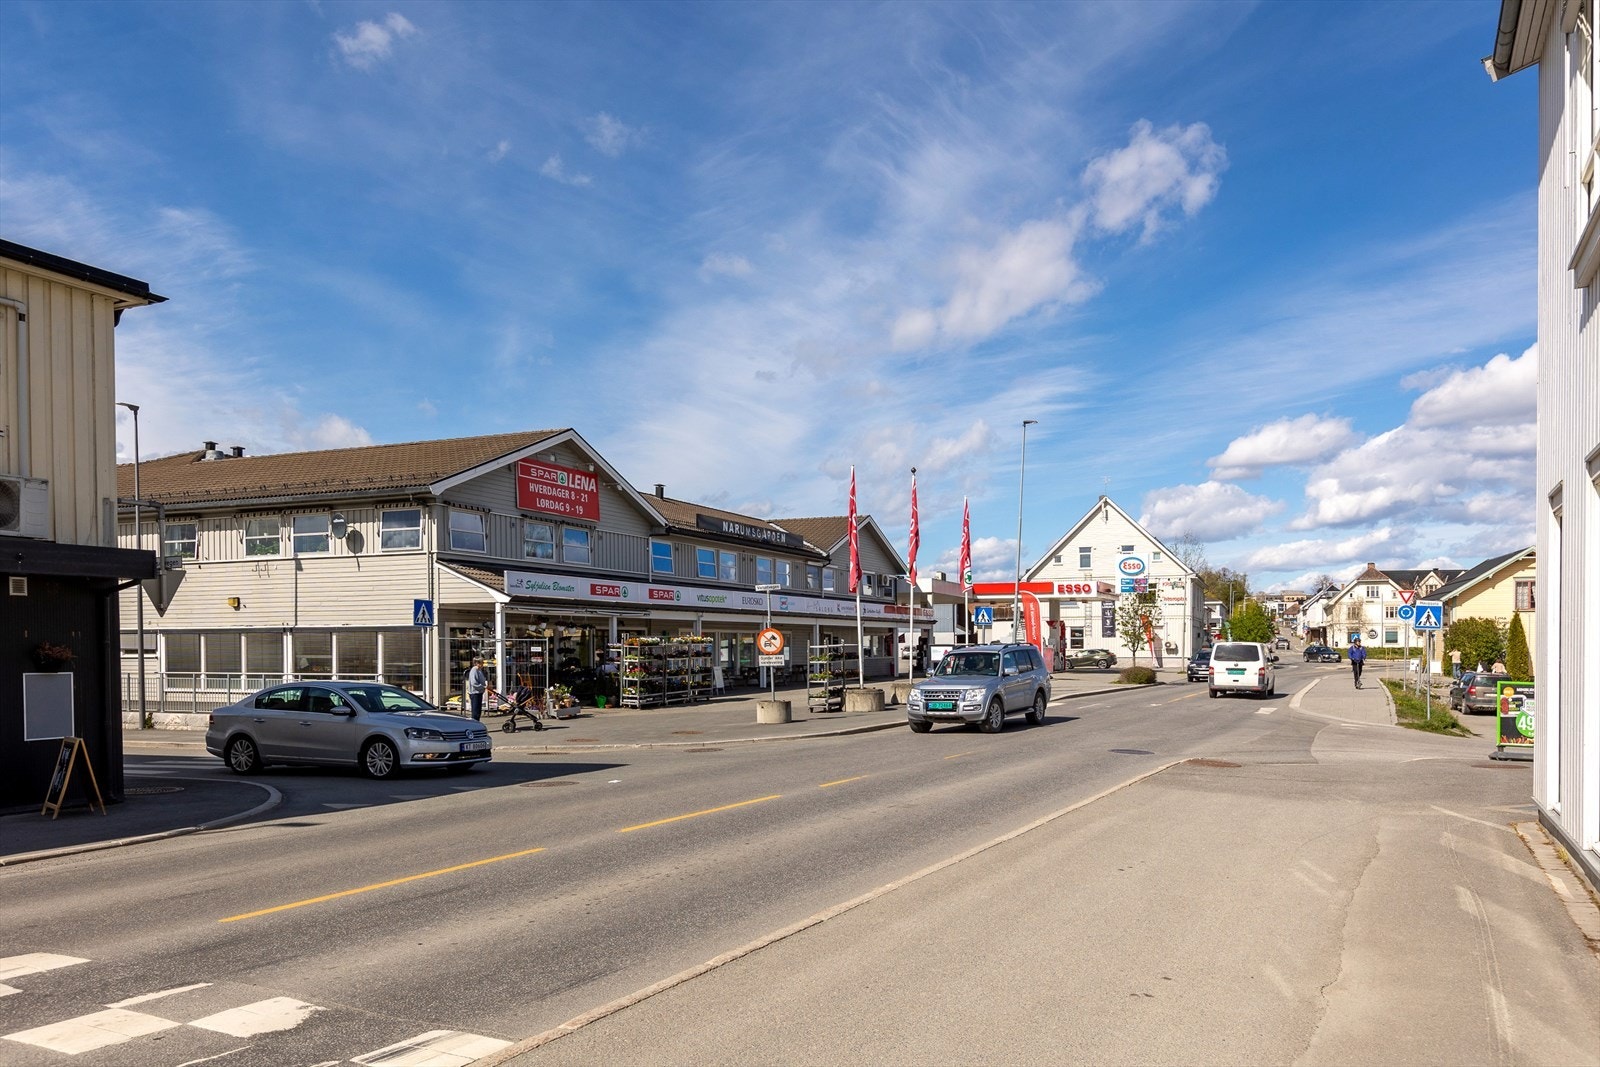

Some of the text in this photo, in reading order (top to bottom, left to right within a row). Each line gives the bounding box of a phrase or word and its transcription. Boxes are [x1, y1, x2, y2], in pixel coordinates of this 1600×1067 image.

[530, 468, 597, 493] SPAR LENA
[529, 482, 570, 499] HVERDAGER
[571, 491, 576, 500] 8
[581, 493, 588, 502] 21
[536, 498, 565, 511] LØRDAG
[566, 504, 570, 512] 9
[575, 505, 584, 515] 19
[595, 586, 620, 595] SPAR
[653, 590, 674, 599] SPAR
[1057, 584, 1092, 595] ESSO
[742, 596, 763, 605] EUROSKO
